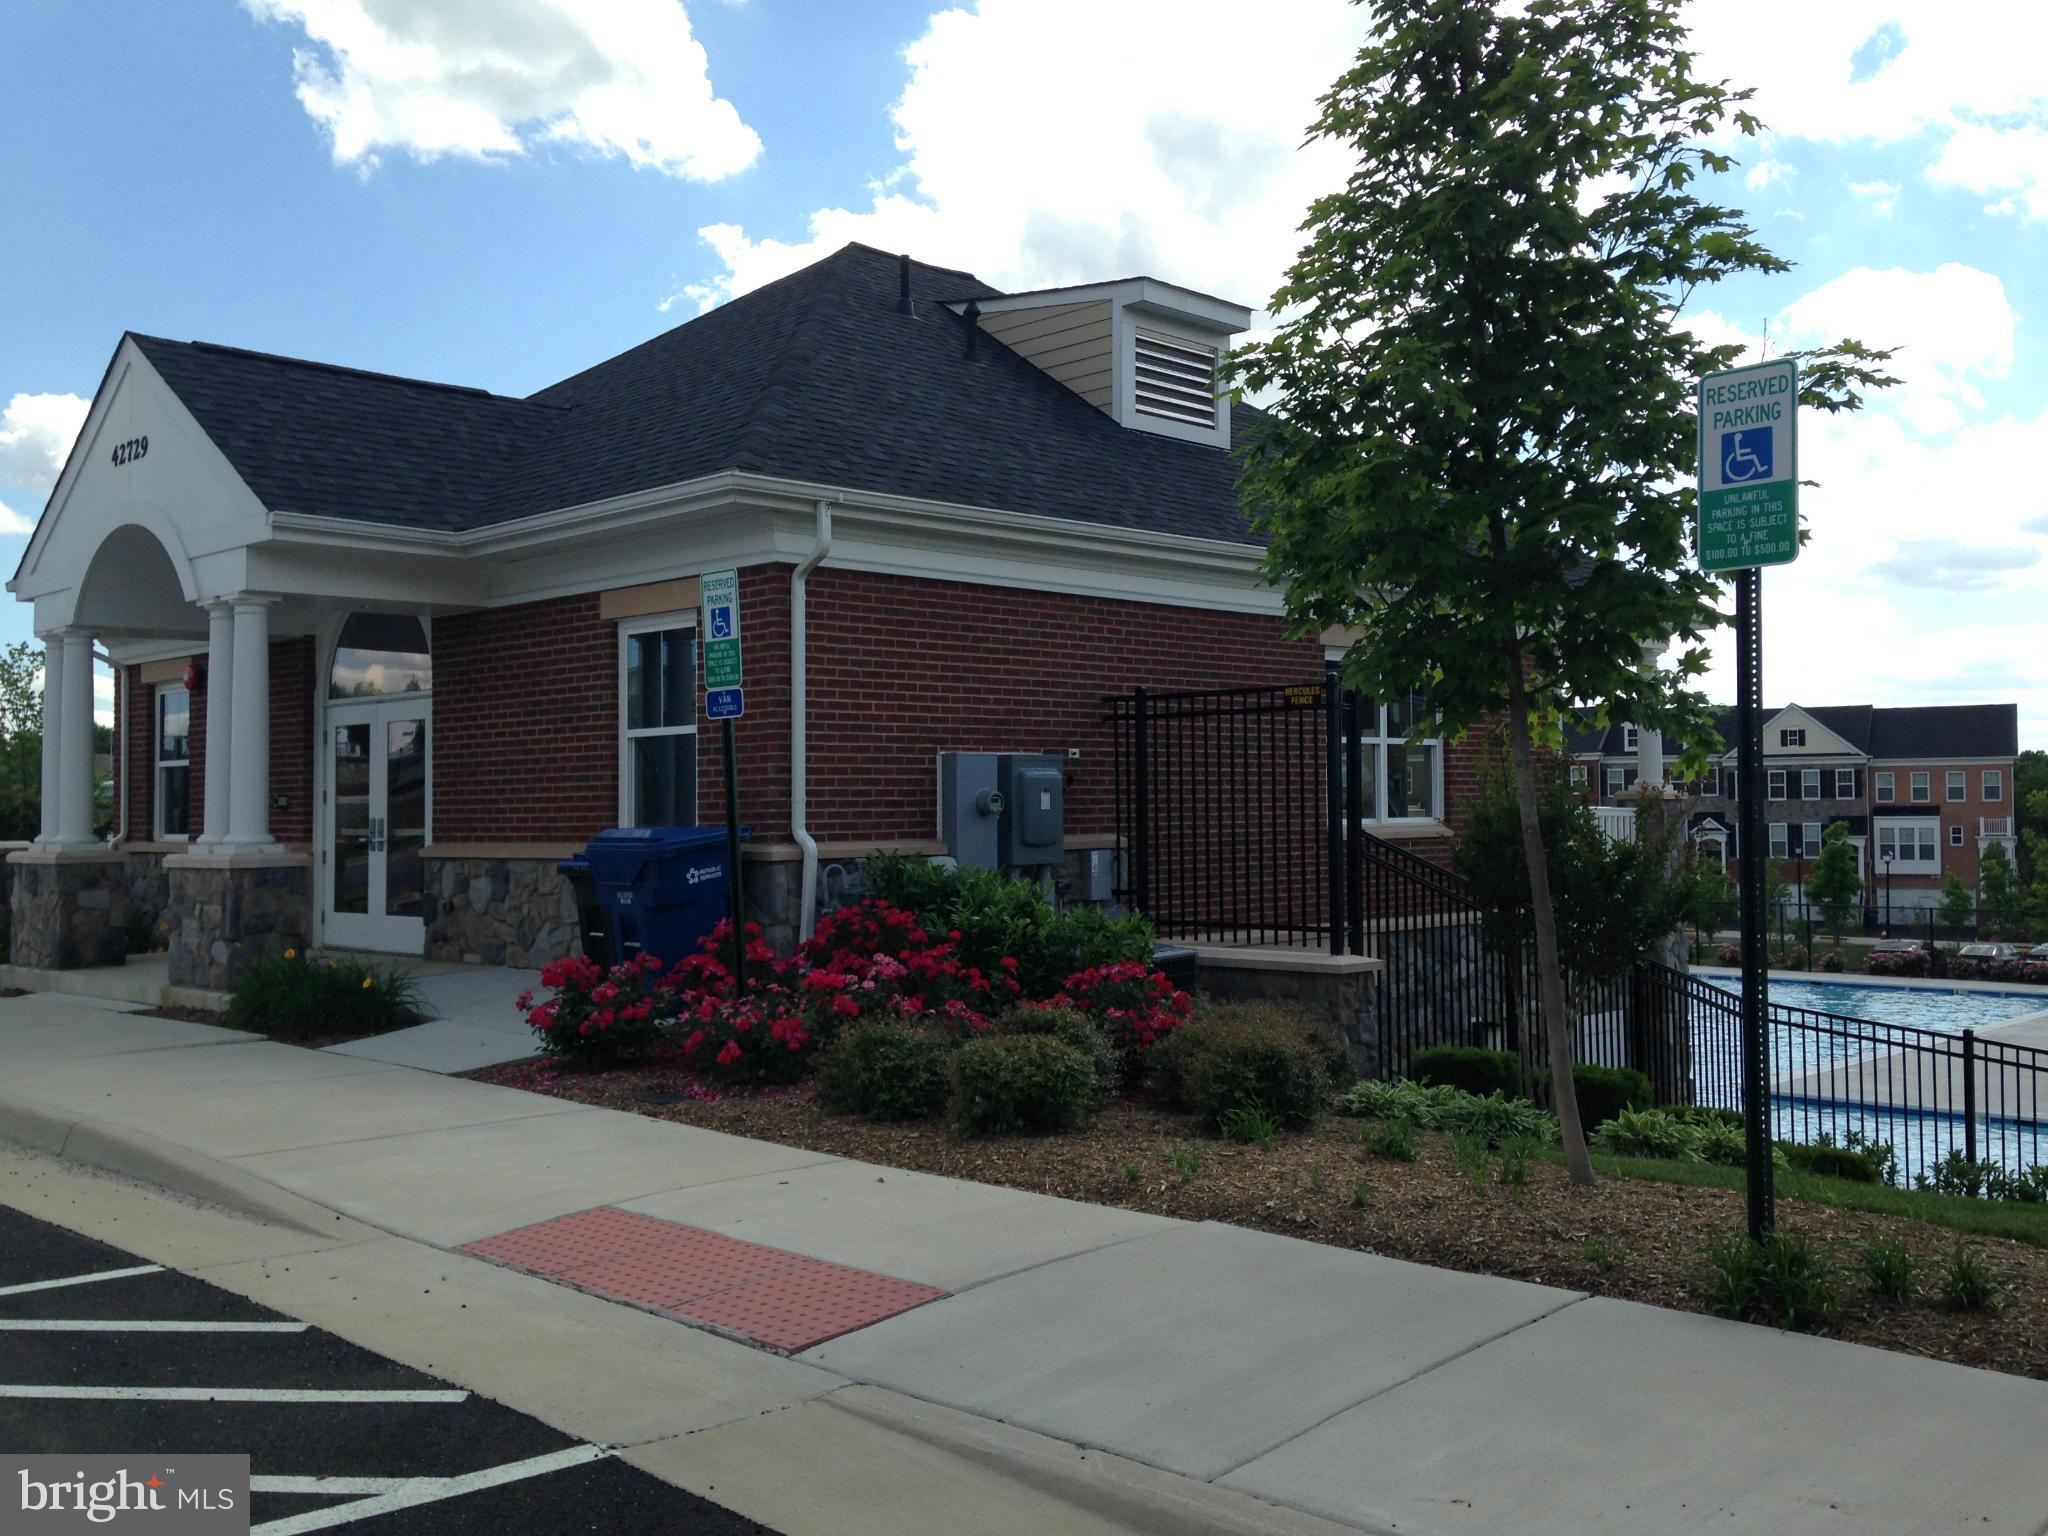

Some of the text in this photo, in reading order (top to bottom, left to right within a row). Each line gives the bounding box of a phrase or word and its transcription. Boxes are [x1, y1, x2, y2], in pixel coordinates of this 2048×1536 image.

[1706, 375, 1789, 406] RESERVED
[1713, 402, 1782, 430] PARKING
[111, 435, 149, 467] 42729
[1723, 489, 1770, 505] UNLAWFUL
[1712, 501, 1783, 520] PARKING IN THIS
[1707, 513, 1788, 534] SPACE IS SUBJECT
[1726, 529, 1769, 544] TO A FINE
[1742, 545, 1751, 556] TO
[1754, 541, 1790, 555] $500.00
[703, 577, 734, 592] RESERVED
[706, 592, 733, 606] PARKING
[718, 695, 732, 704] VAN
